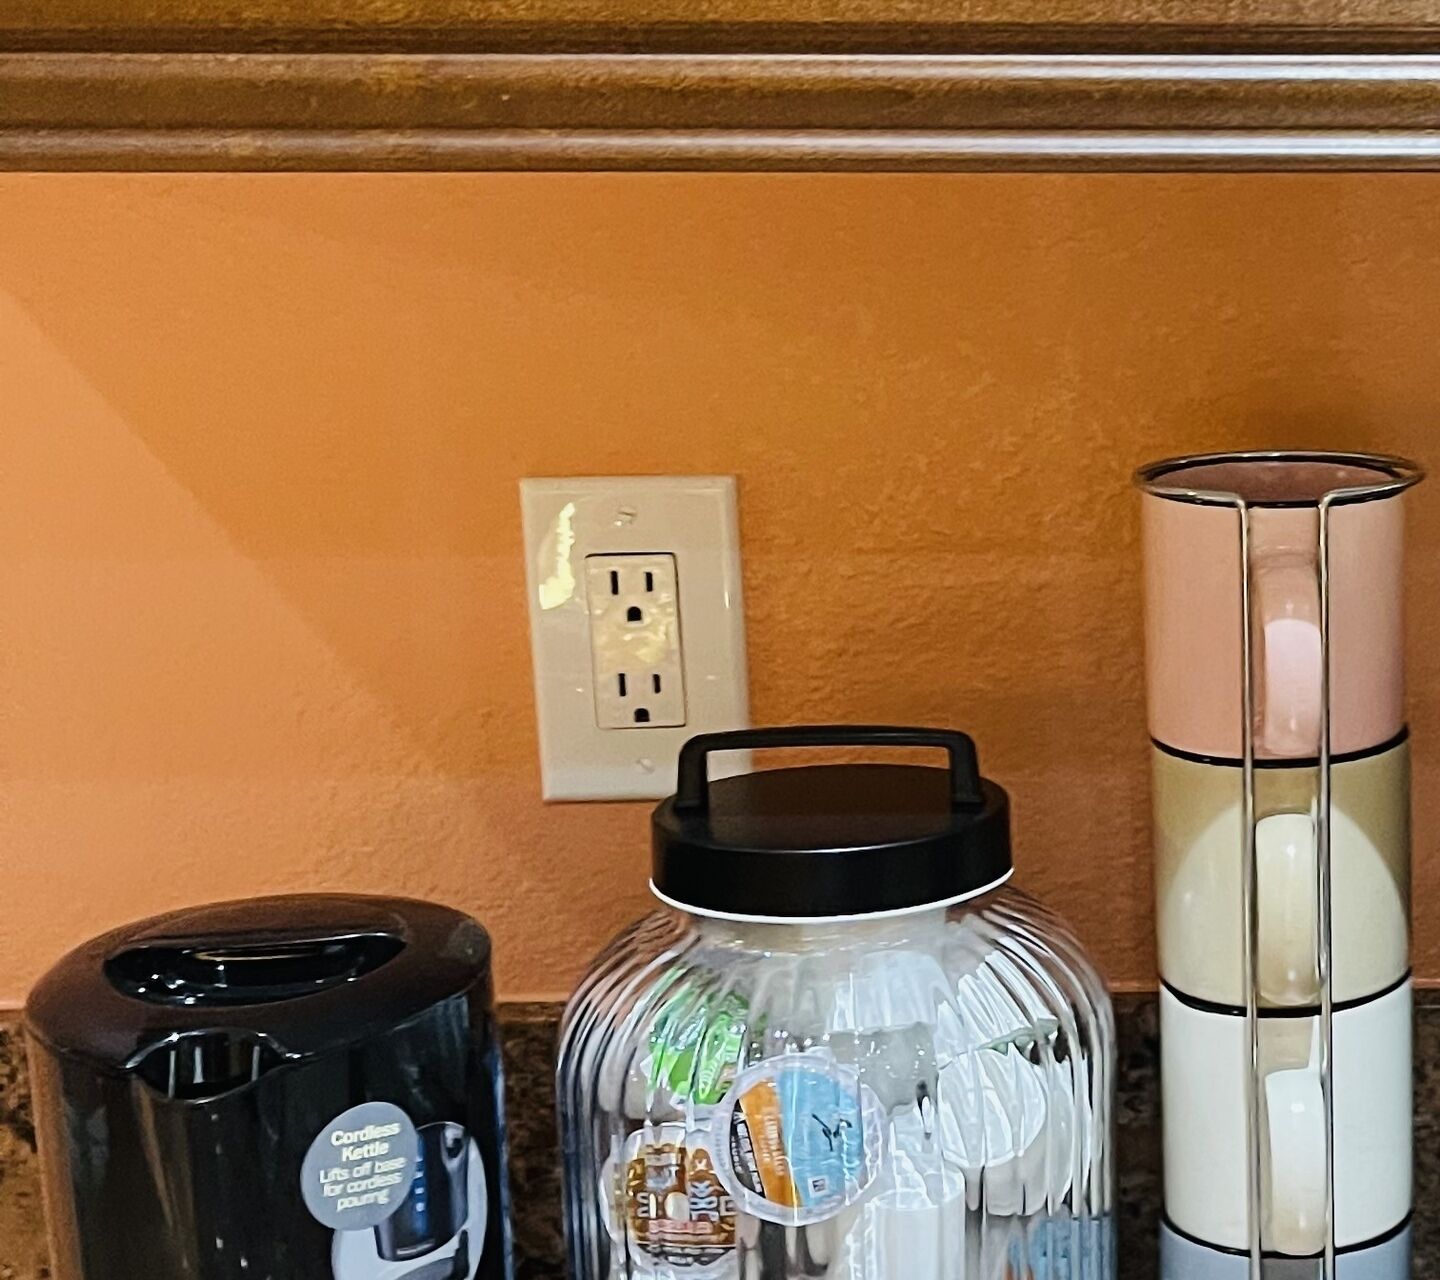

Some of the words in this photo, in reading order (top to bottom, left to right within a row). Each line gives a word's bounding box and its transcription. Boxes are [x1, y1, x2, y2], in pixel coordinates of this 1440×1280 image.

[331, 1123, 401, 1146] Cordless
[342, 1141, 389, 1161] Kettle
[320, 1167, 350, 1183] Lifts
[353, 1161, 373, 1177] off
[374, 1157, 406, 1173] base
[324, 1183, 344, 1197] for
[346, 1172, 402, 1193] cordless
